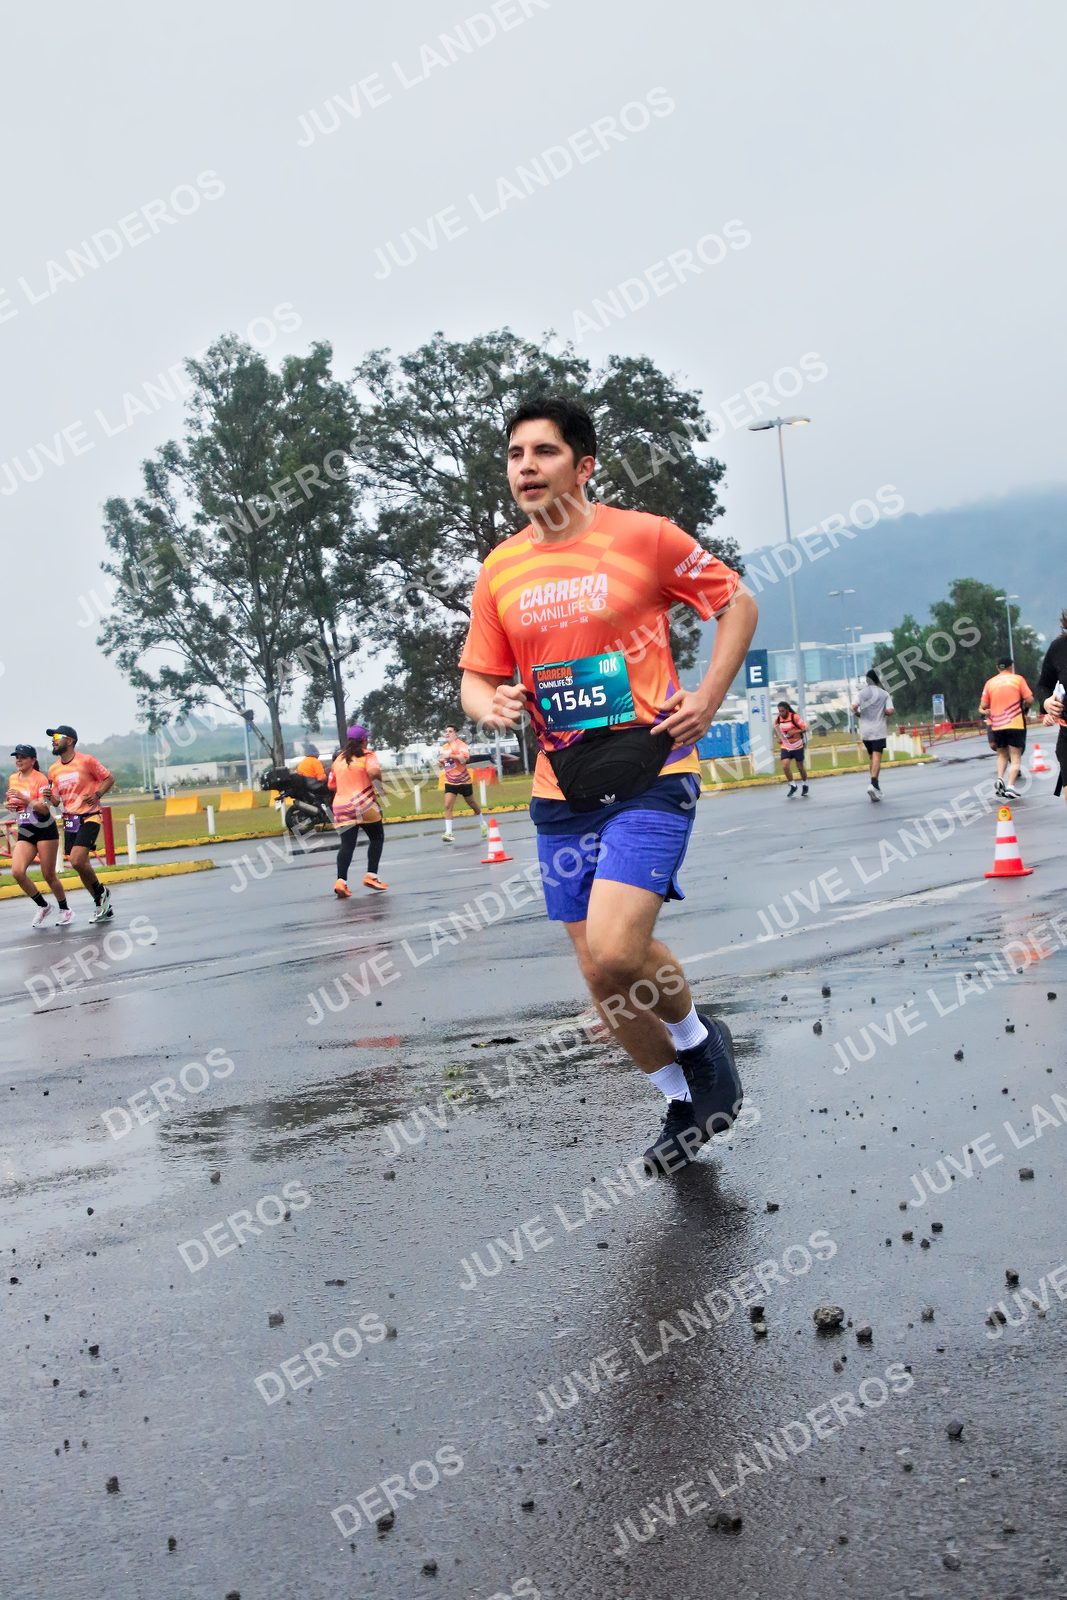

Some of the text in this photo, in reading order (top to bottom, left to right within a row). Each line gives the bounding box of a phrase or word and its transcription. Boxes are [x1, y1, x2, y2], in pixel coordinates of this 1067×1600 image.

[520, 573, 608, 610] CARRERA
[521, 598, 586, 626] OMNILIFE
[536, 666, 573, 682] CARRERA
[598, 657, 617, 675] 10K
[749, 665, 763, 683] E
[538, 679, 565, 690] OMNILIFE
[551, 685, 607, 712] 1545
